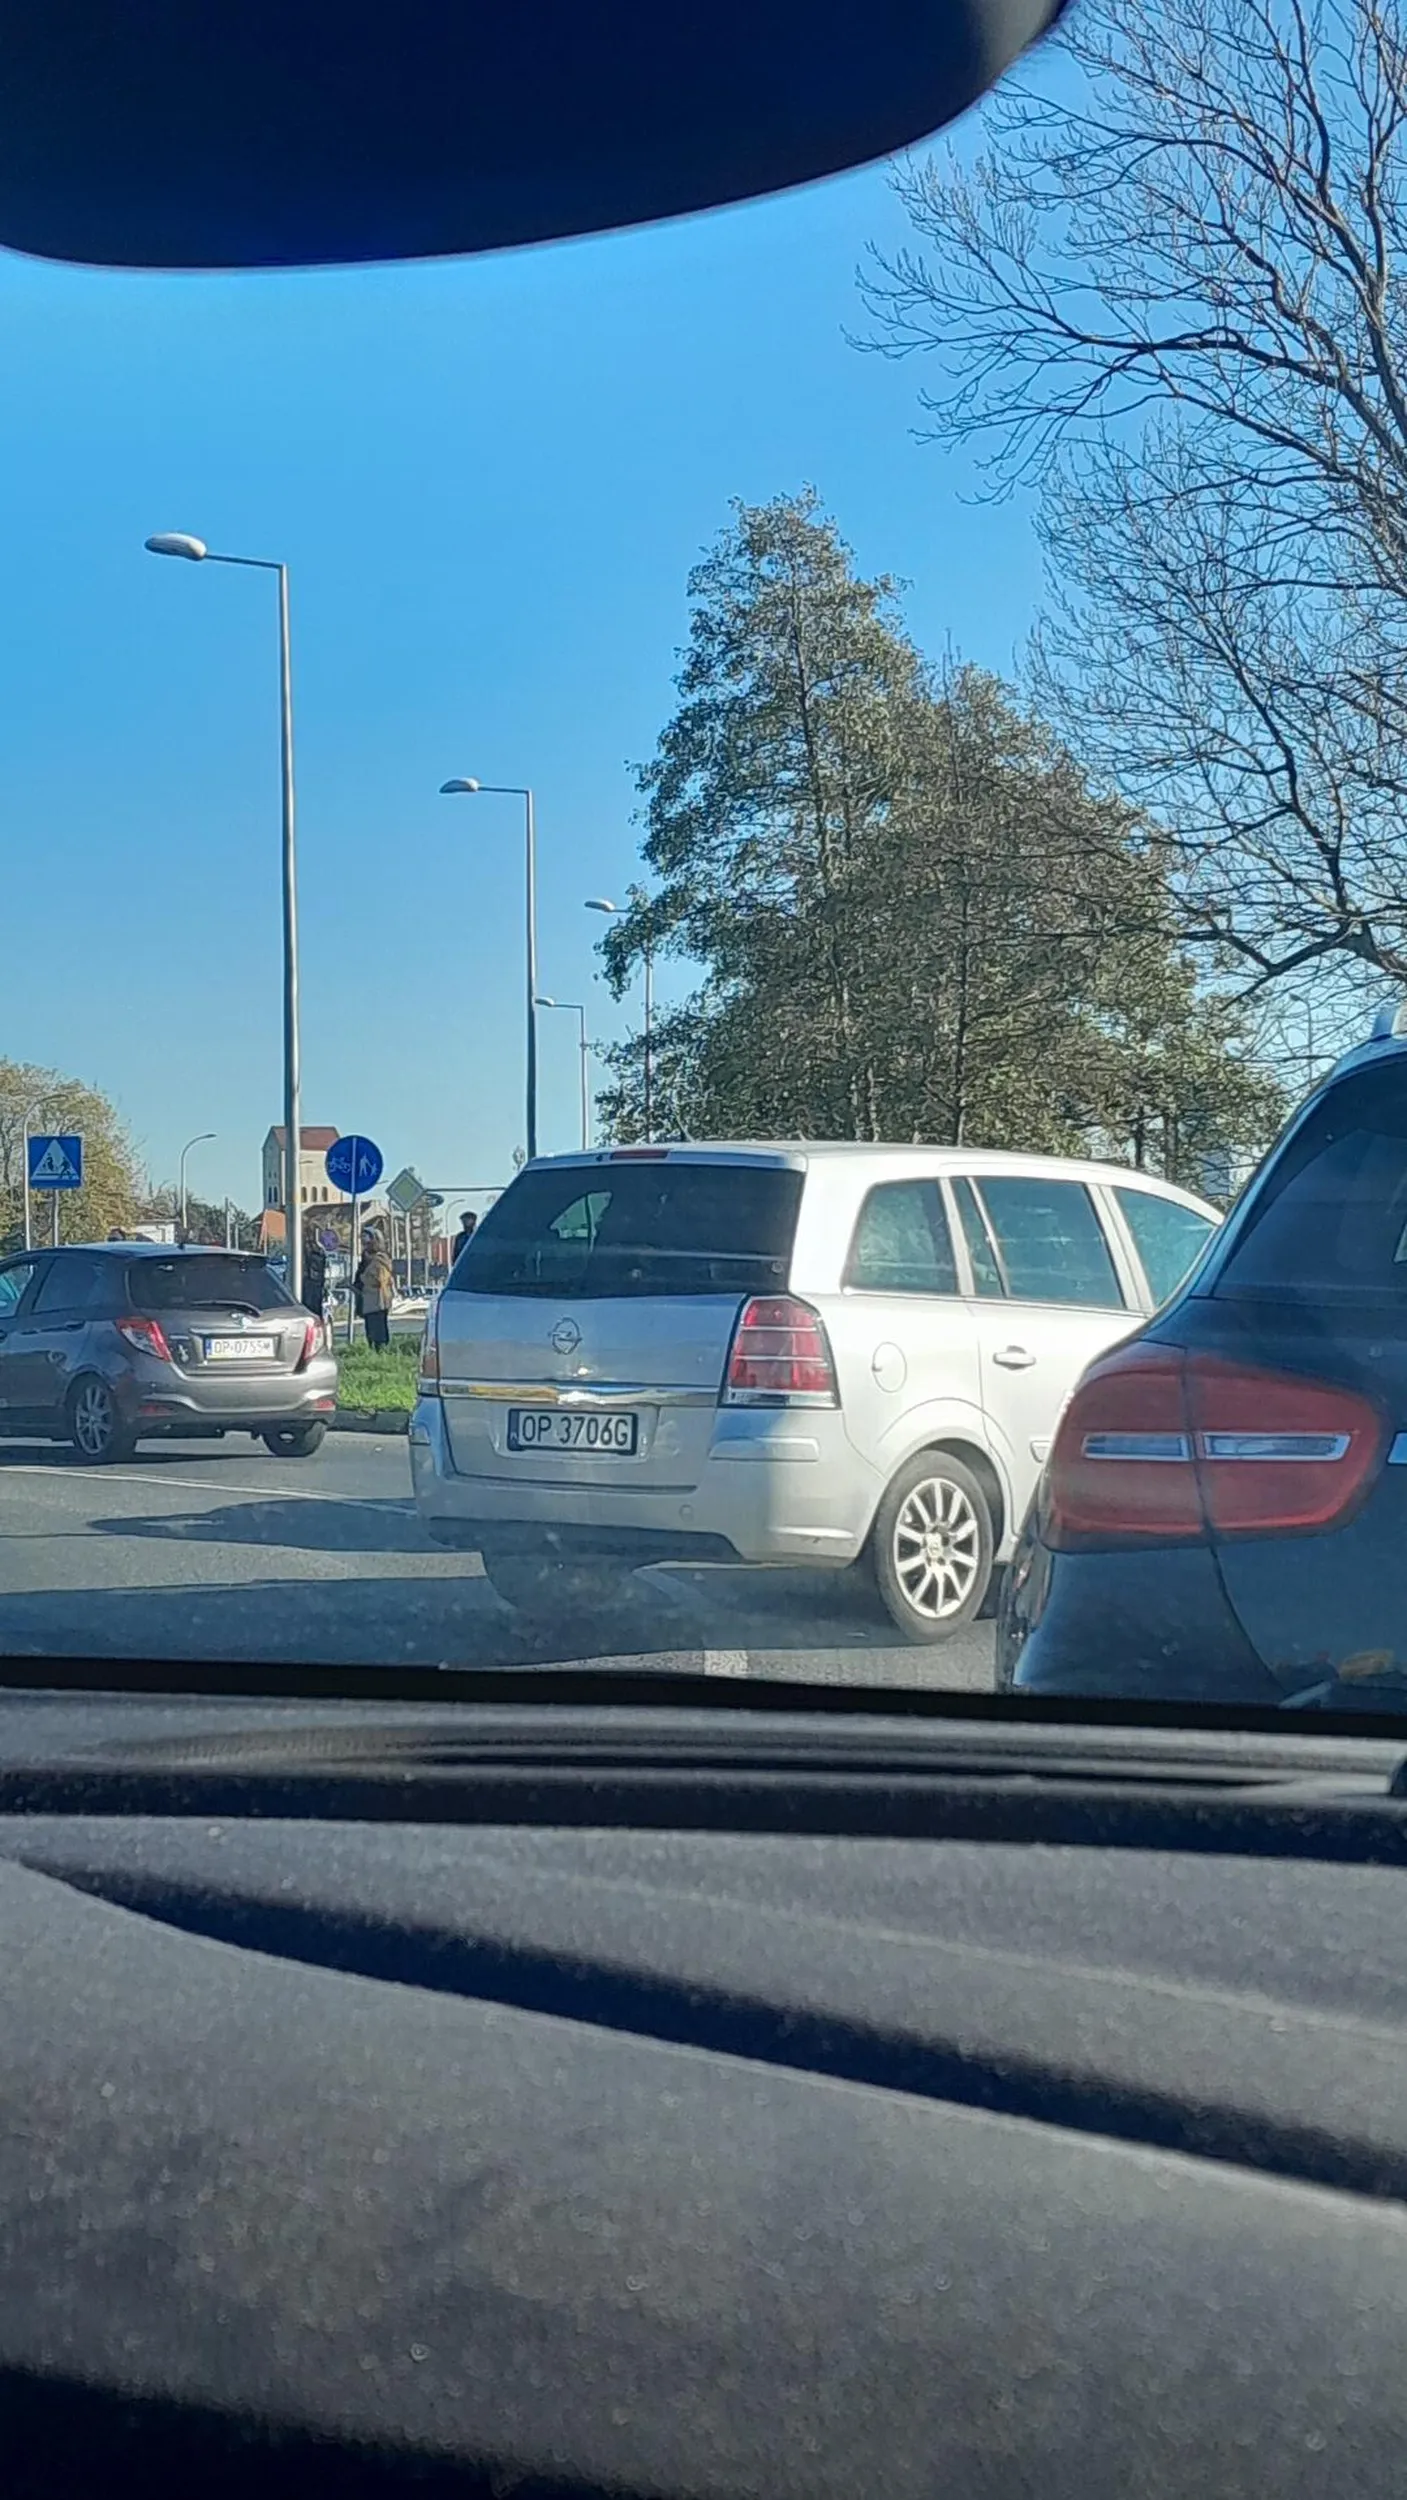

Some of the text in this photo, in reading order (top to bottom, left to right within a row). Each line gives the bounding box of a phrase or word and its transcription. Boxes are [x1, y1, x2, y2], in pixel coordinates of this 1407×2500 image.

[214, 1341, 230, 1354] OP
[522, 1415, 628, 1446] OP 3706G
